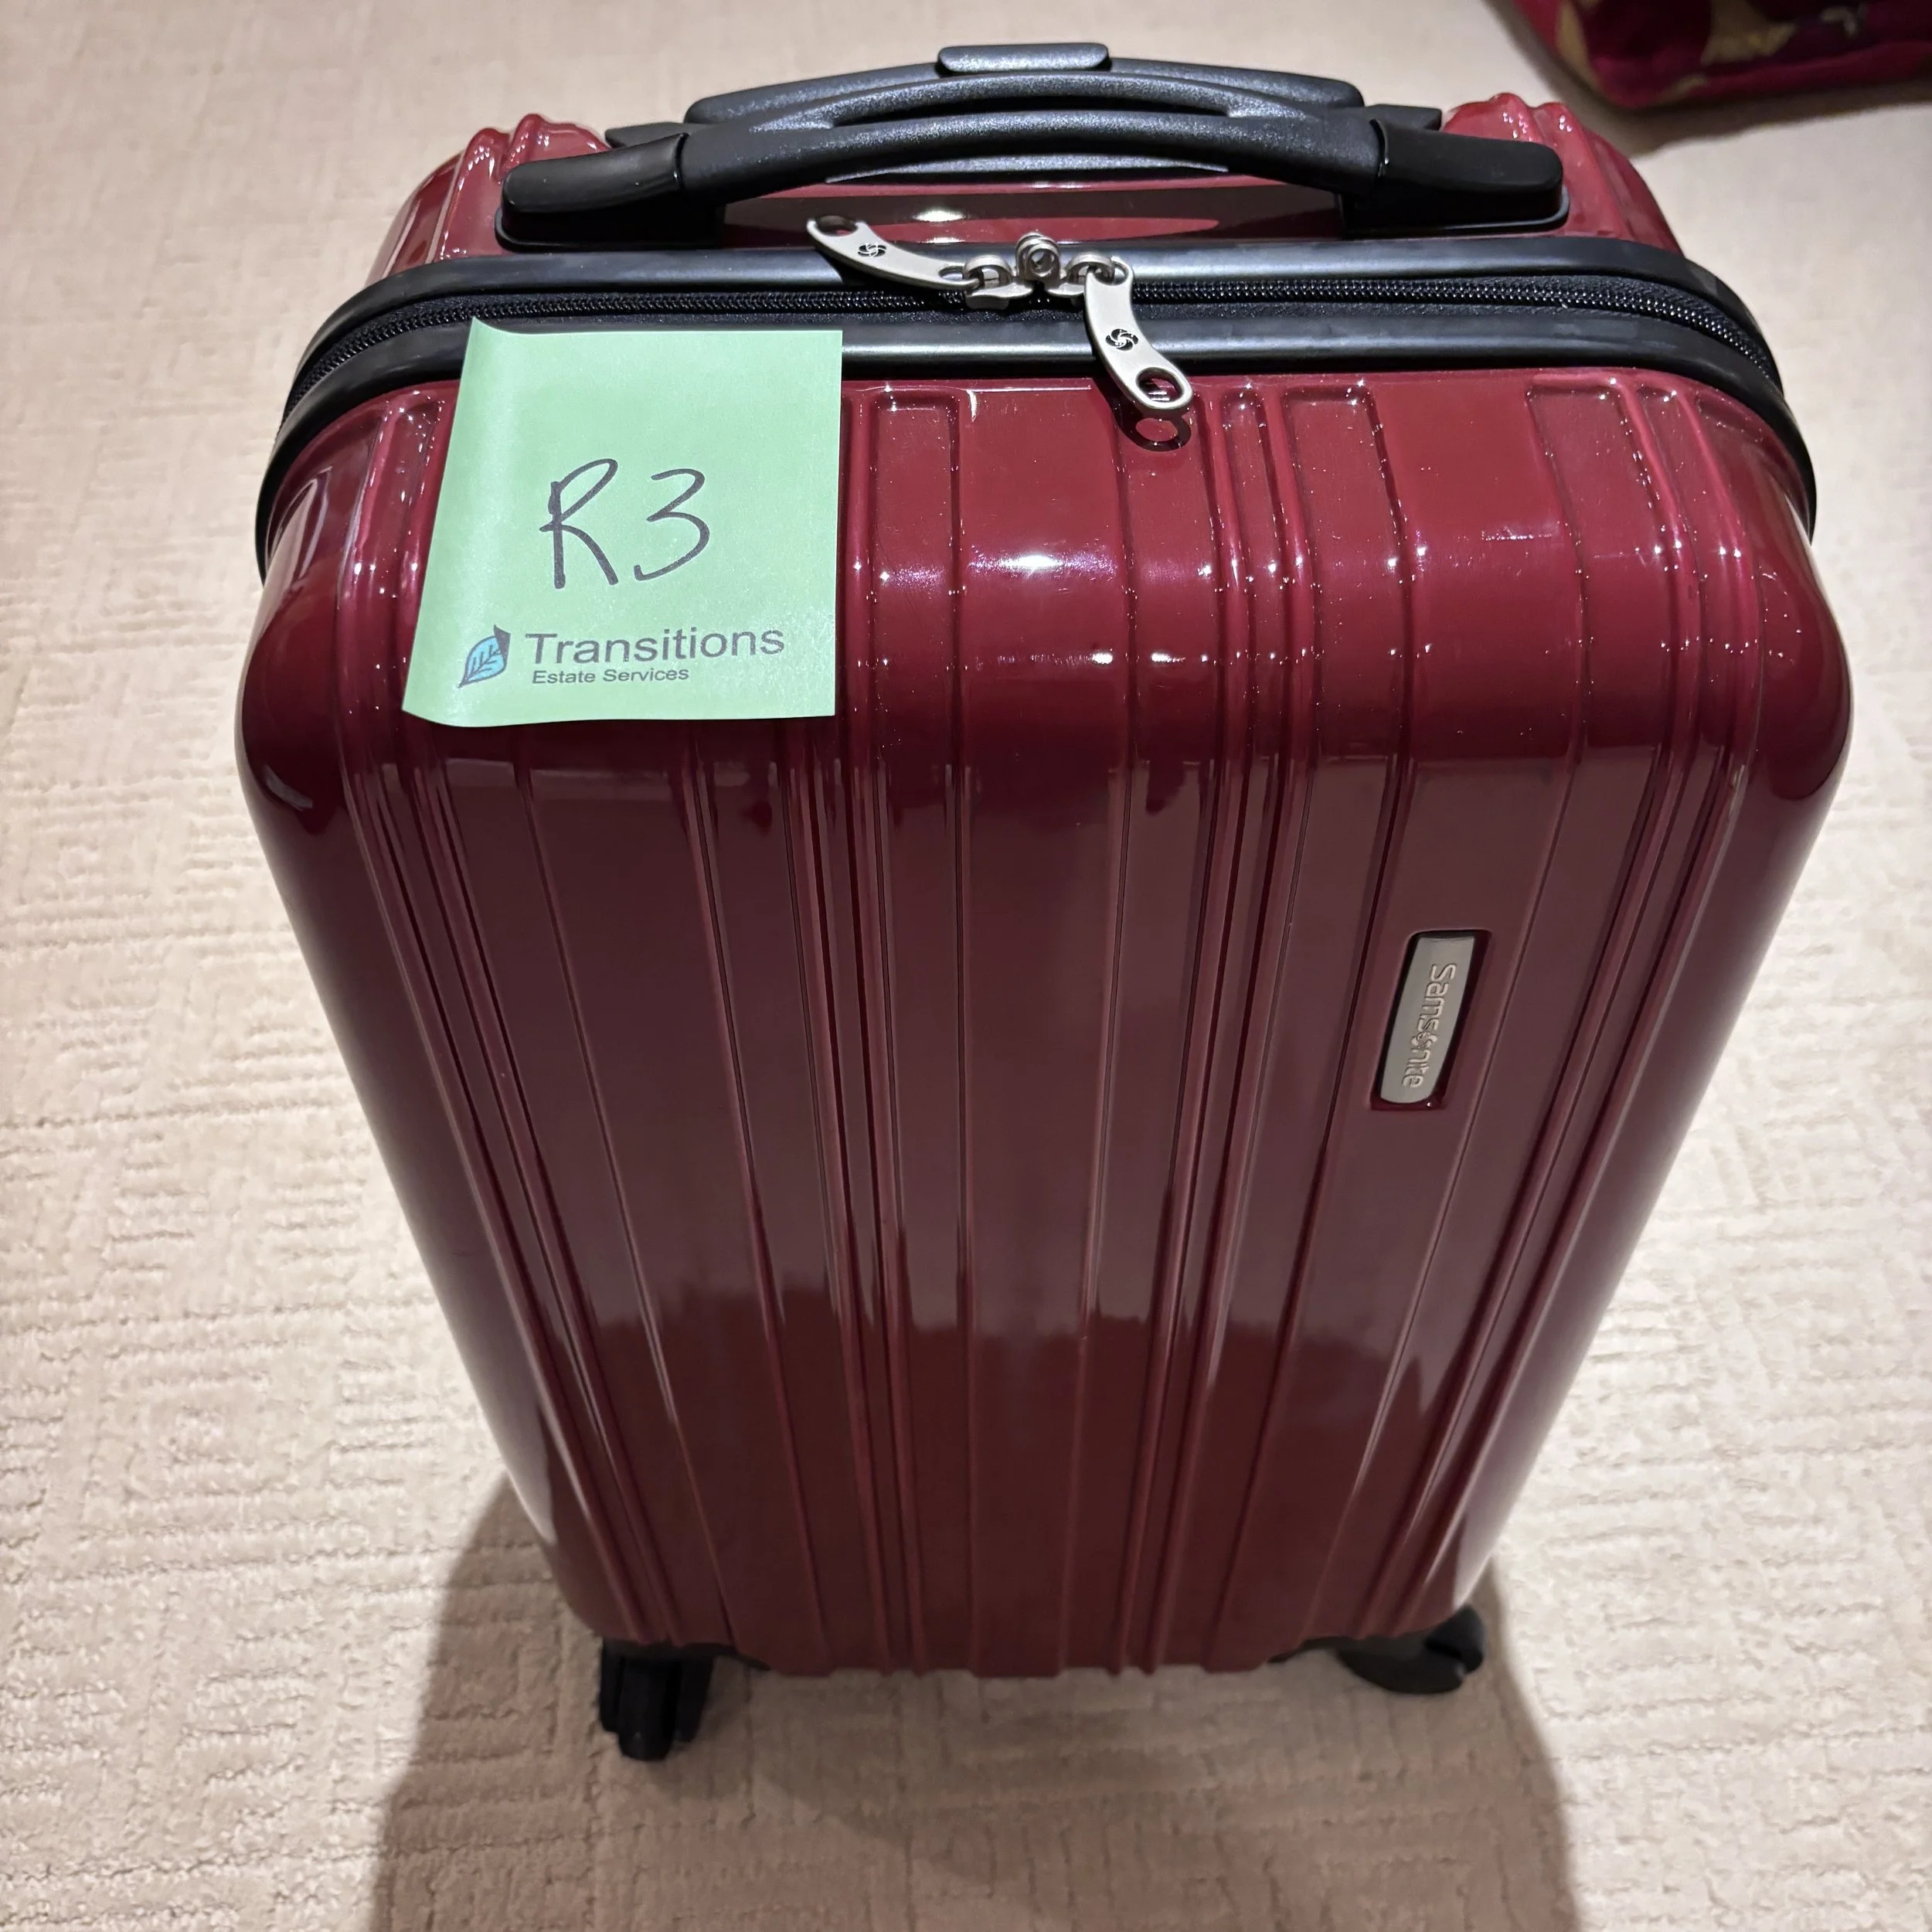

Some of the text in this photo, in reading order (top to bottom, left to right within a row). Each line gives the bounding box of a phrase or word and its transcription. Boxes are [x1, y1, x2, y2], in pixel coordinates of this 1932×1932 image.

[539, 457, 710, 590] R3
[526, 626, 785, 665] Transitions
[532, 667, 690, 685] Estate Services
[1401, 964, 1457, 1088] Samsonite
